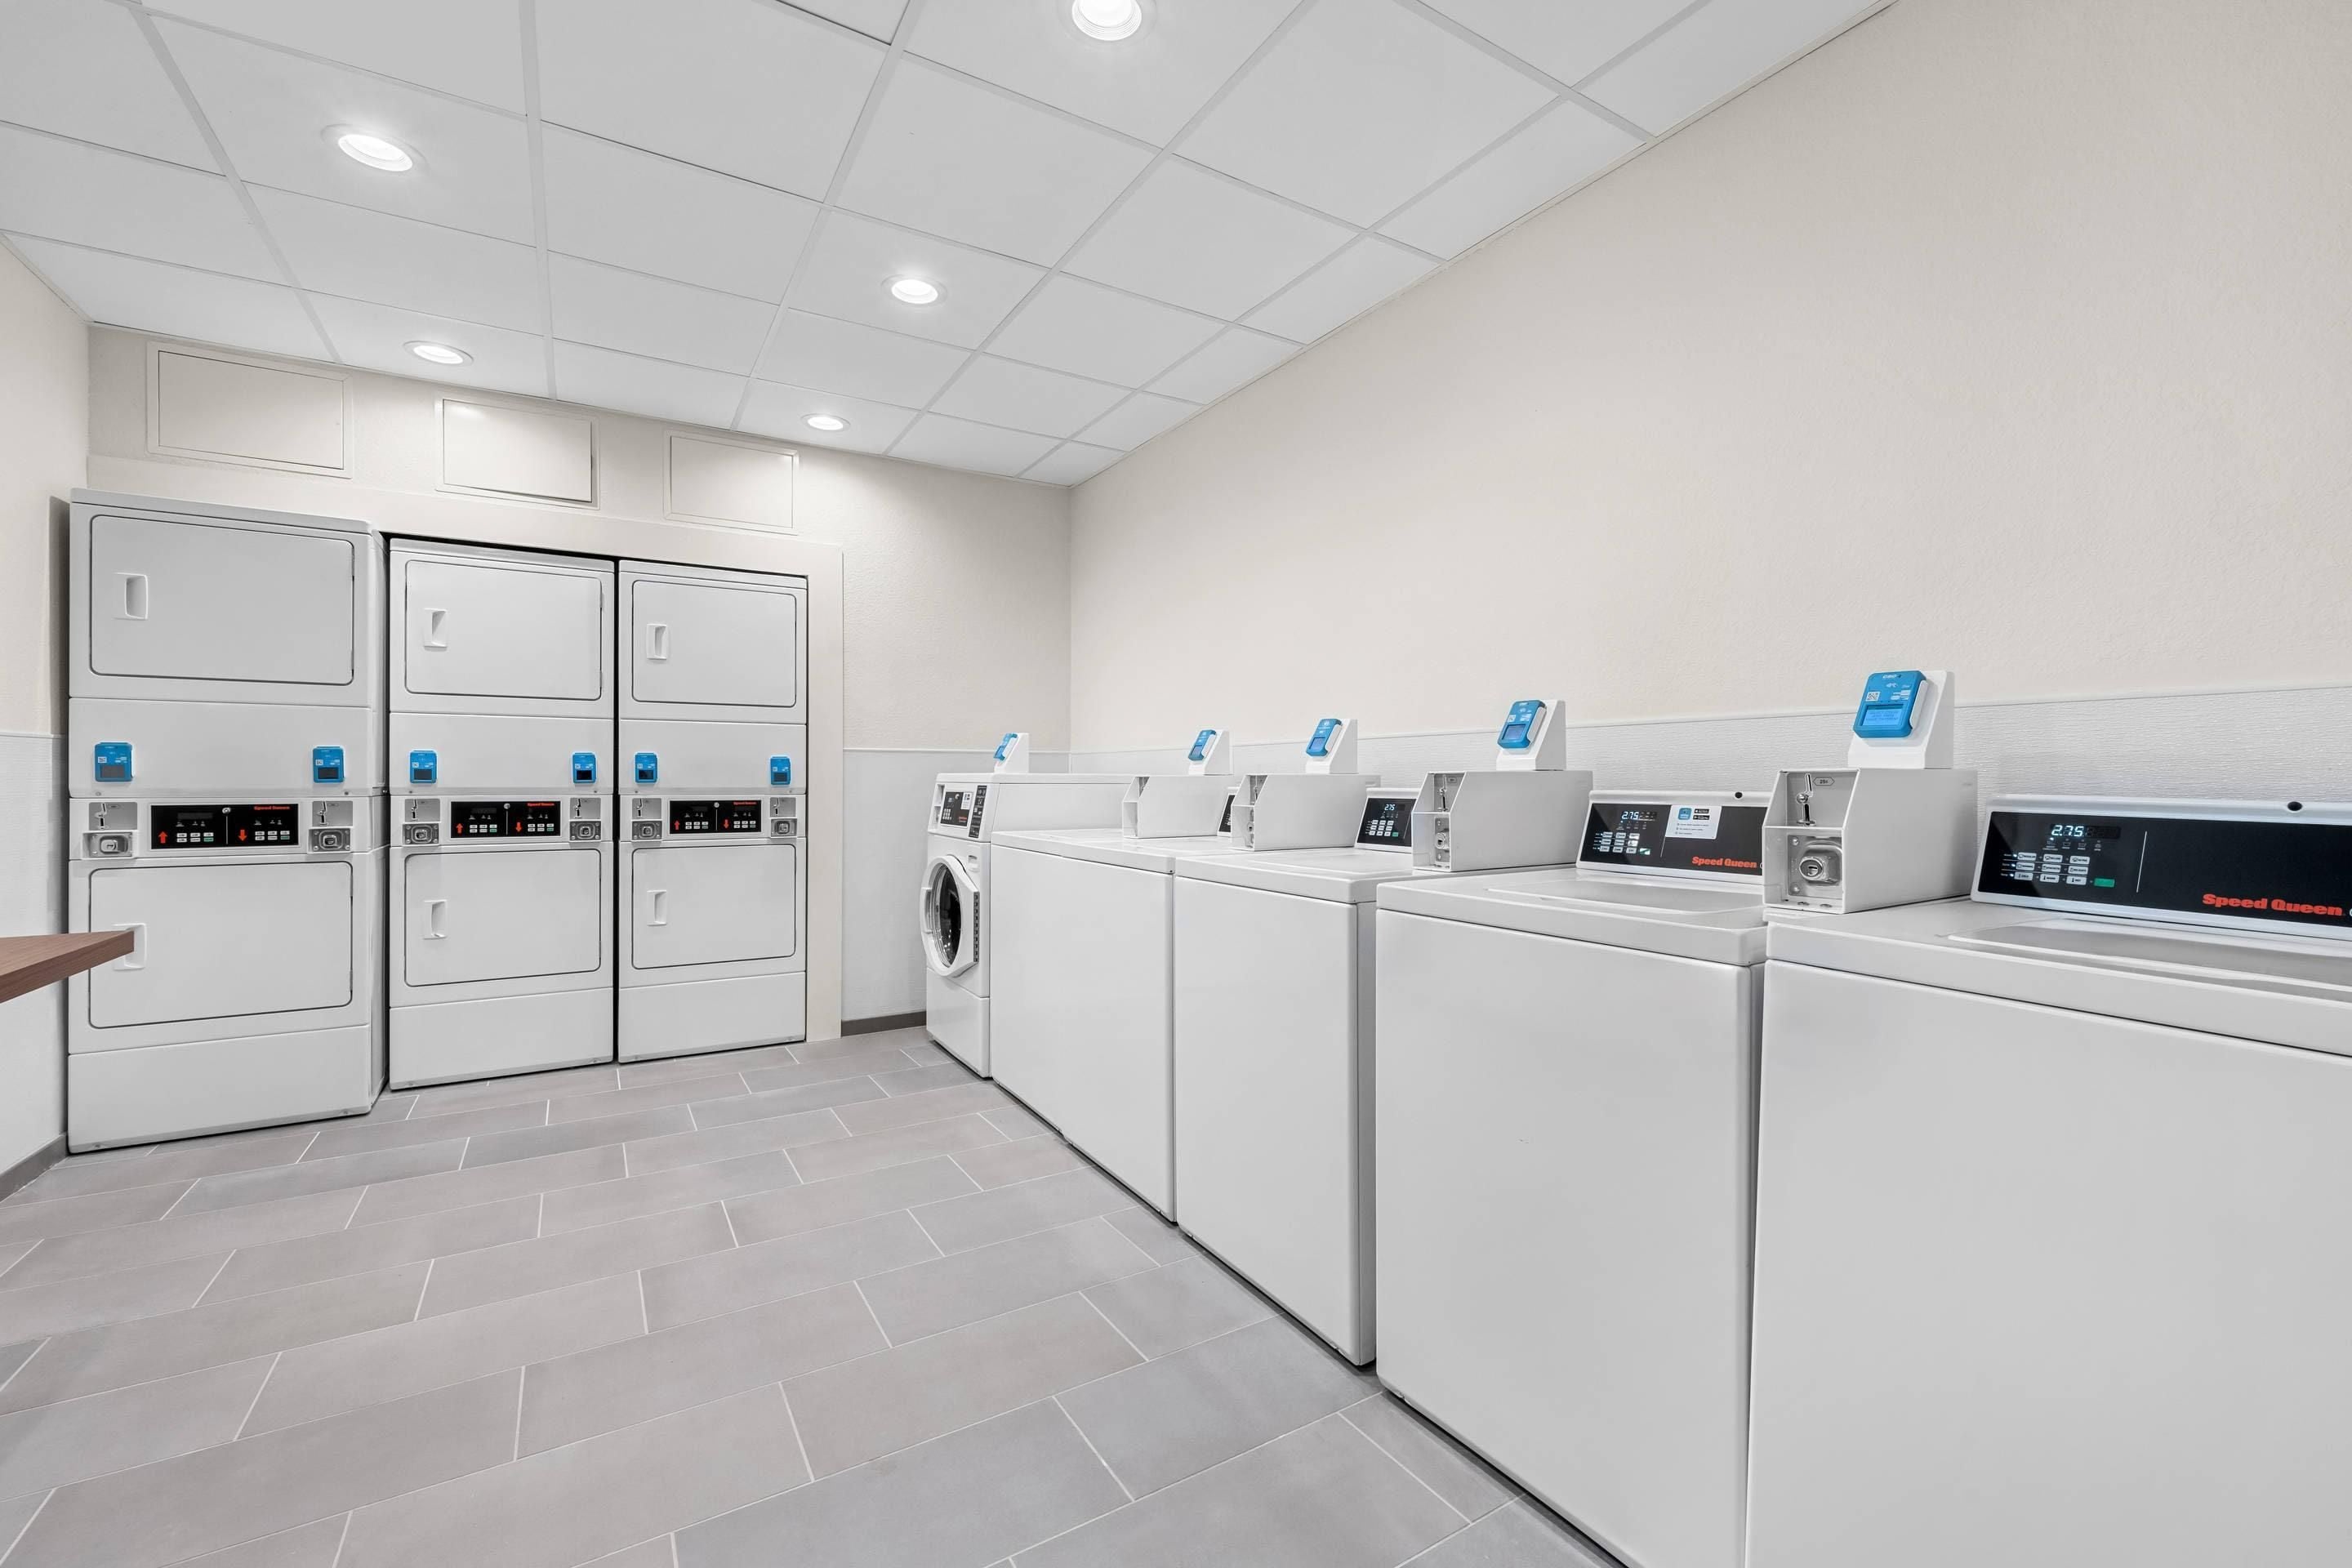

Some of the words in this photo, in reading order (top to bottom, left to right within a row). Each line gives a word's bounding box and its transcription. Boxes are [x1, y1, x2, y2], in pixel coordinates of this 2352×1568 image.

[2051, 824, 2084, 837] 2.75
[1692, 856, 1724, 866] Speed
[1724, 858, 1756, 868] Queen
[2203, 893, 2268, 909] Speed
[2270, 898, 2343, 916] Queen
